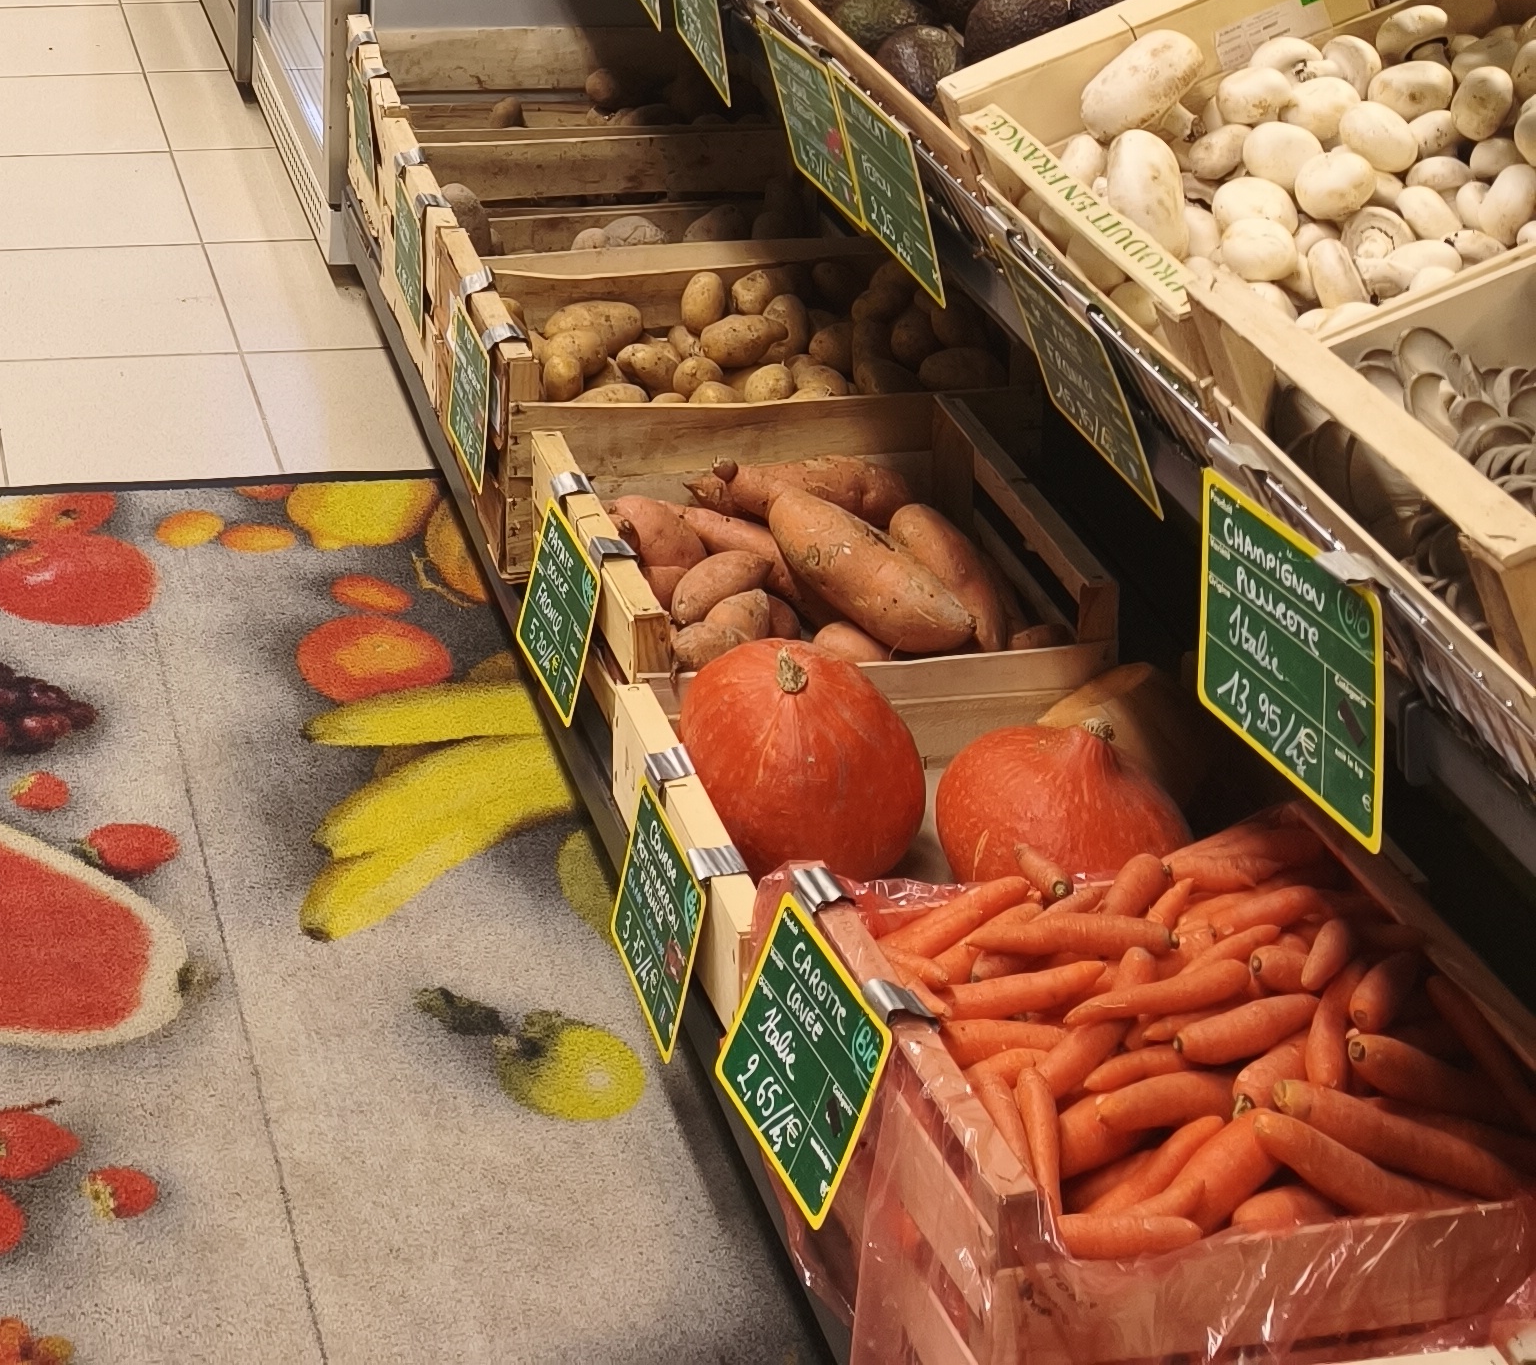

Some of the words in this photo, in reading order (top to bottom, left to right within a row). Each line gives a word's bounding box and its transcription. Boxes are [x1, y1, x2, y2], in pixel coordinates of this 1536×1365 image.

[991, 114, 1066, 187] FRANCE
[1057, 183, 1100, 214] EN
[1084, 211, 1186, 294] PRODUIT
[547, 525, 575, 577] PATATE
[1222, 516, 1327, 612] CHAMPIGNON
[1228, 603, 1289, 683] Italie
[792, 940, 848, 1037] CAROTTE
[756, 1006, 796, 1082] Italie
